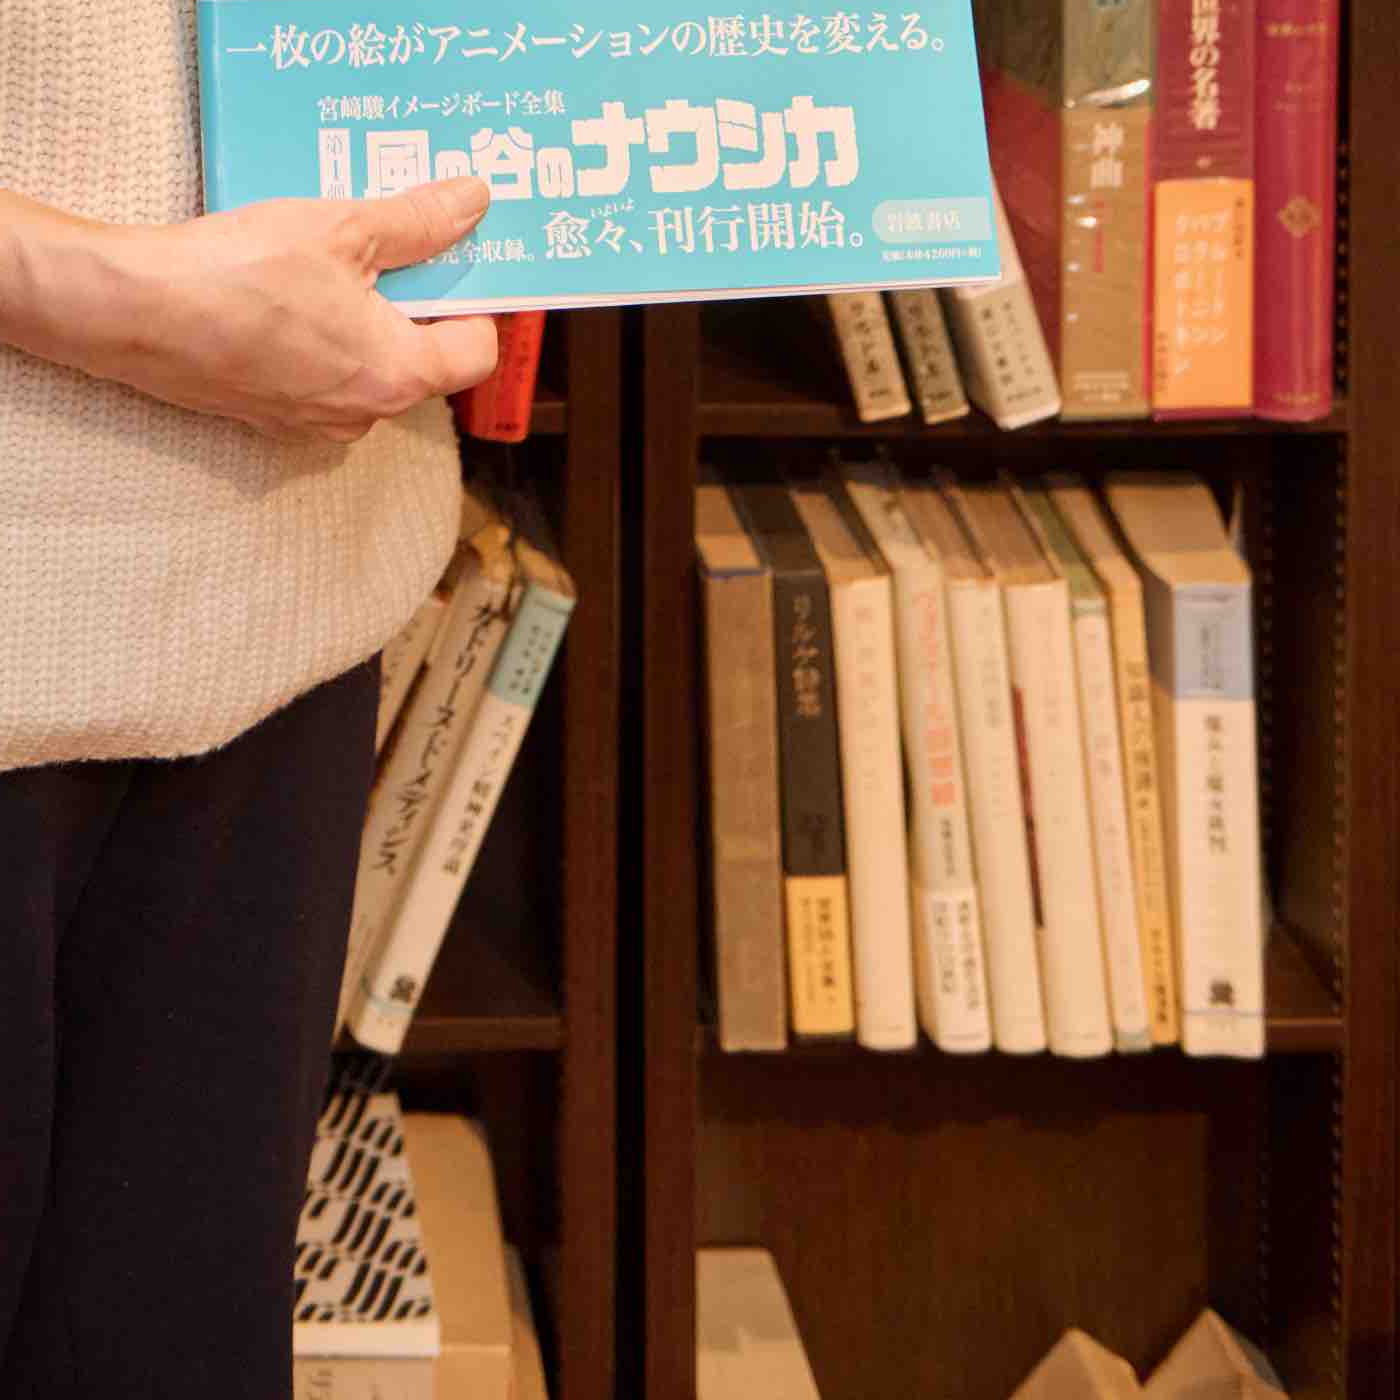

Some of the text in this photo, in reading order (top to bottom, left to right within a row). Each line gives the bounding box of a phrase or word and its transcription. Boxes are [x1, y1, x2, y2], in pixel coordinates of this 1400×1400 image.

[225, 11, 947, 72] 一枚の絵がアニメーションの歴史を変える。
[364, 95, 861, 201] 風の谷のナウシカ
